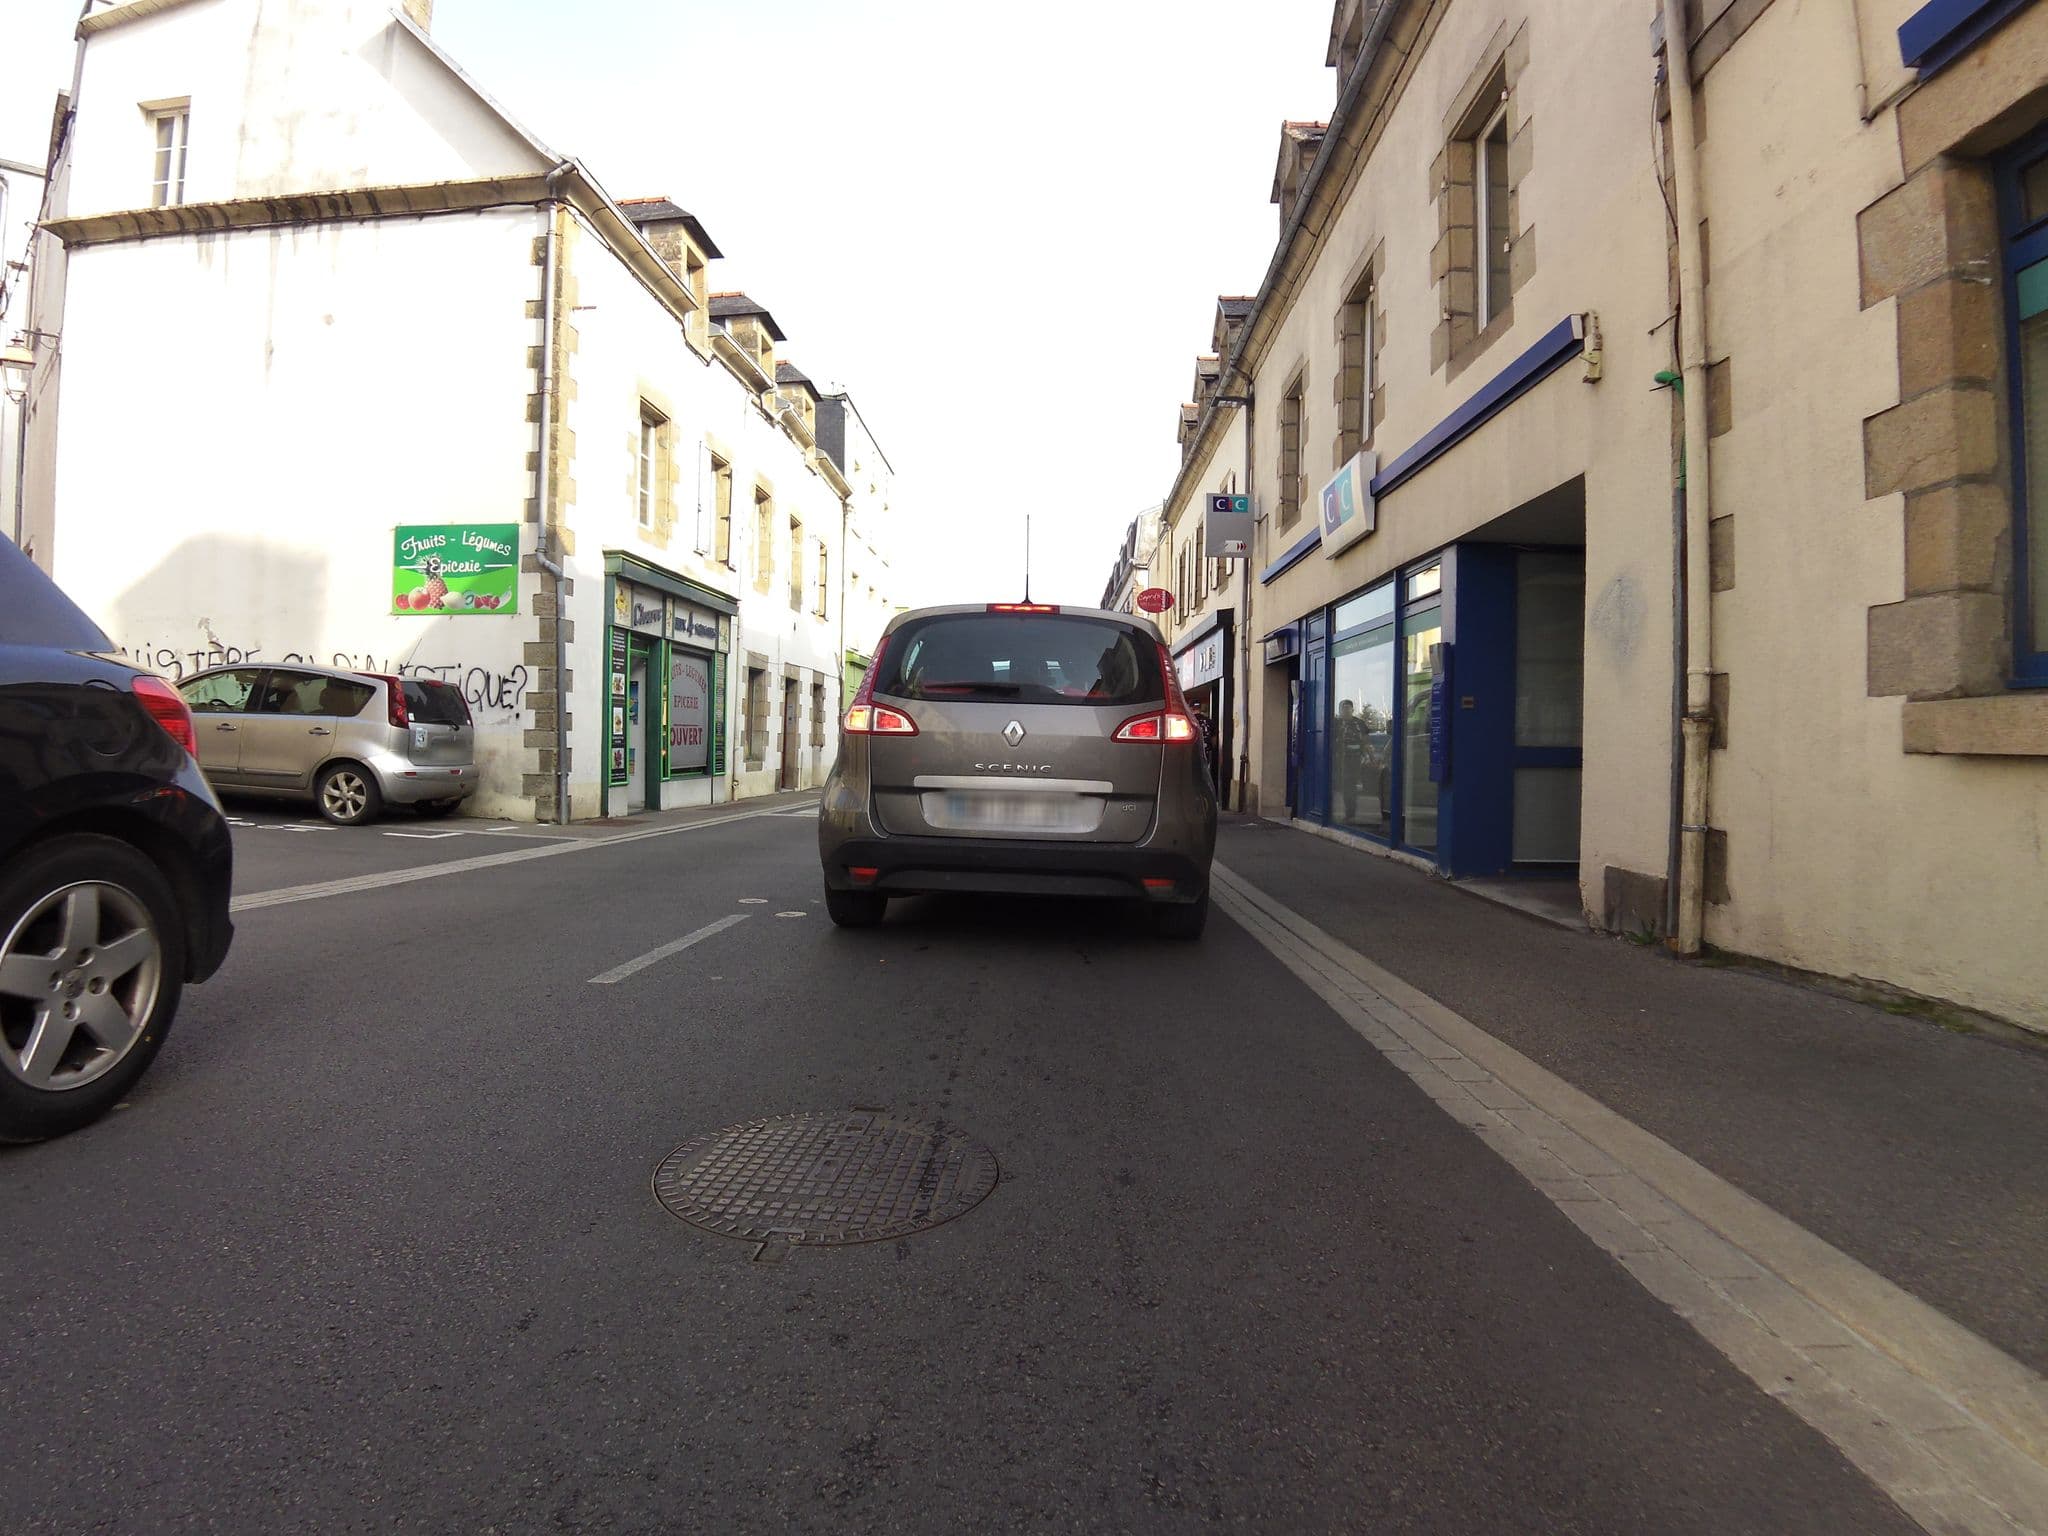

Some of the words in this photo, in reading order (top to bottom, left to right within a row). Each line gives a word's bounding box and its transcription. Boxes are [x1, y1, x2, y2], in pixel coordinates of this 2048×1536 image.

[1215, 498, 1246, 511] CIC
[1325, 479, 1351, 524] CIC
[401, 534, 447, 560] Fruits
[462, 530, 512, 556] Légumes
[430, 557, 482, 576] Epicerie
[673, 695, 700, 710] EPICERIE
[670, 727, 703, 746] OUVERT
[974, 763, 1052, 774] SCENIC
